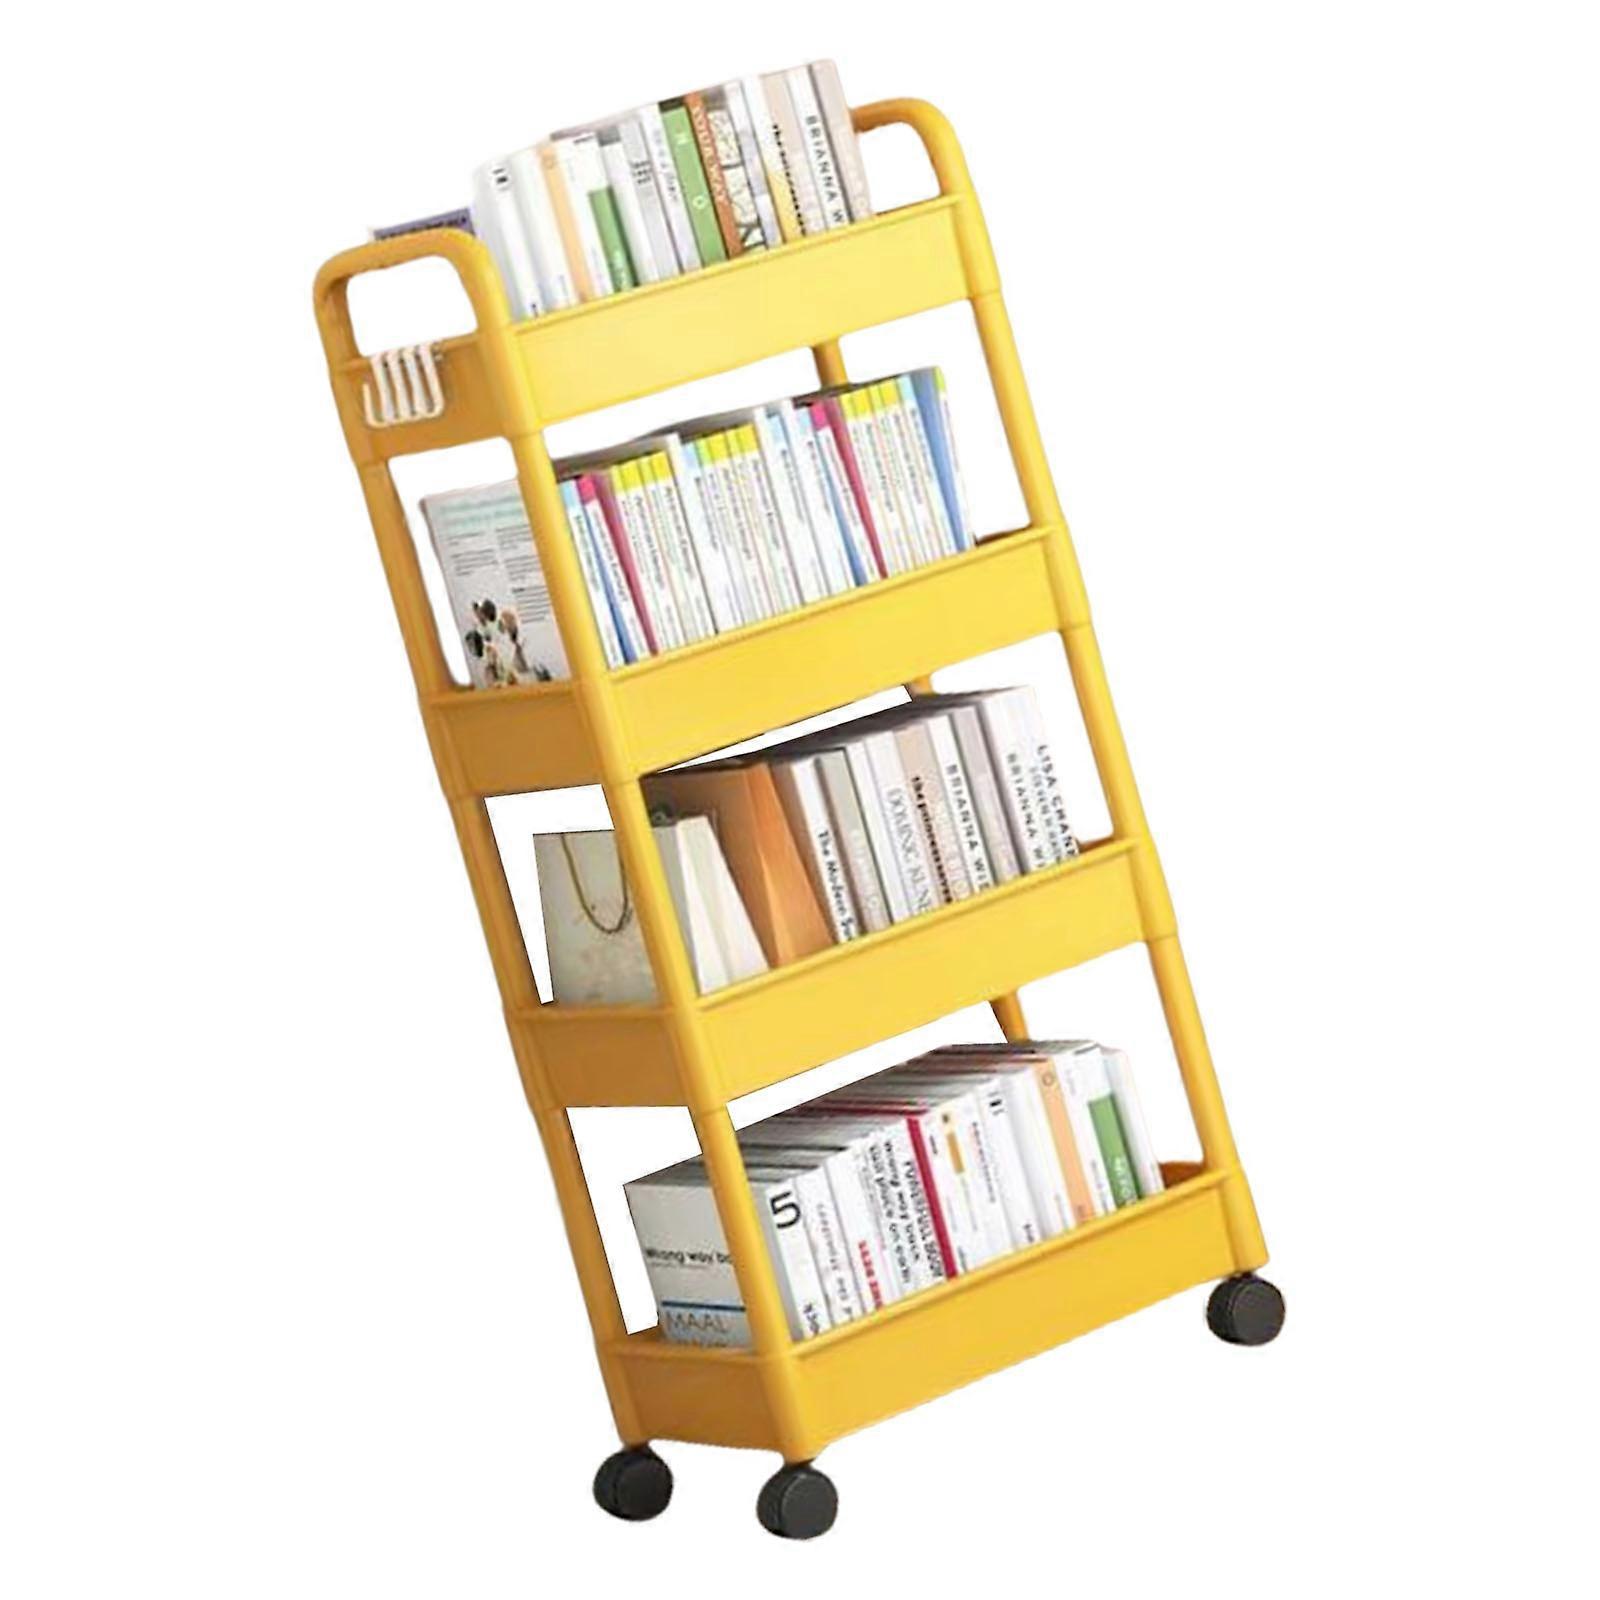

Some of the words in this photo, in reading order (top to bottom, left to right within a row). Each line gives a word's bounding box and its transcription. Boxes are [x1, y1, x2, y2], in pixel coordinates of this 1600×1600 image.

[805, 115, 838, 202] BRIANNA
[1007, 753, 1038, 839] BRIANNA
[1037, 744, 1057, 789] LISA
[817, 829, 831, 857] The
[887, 788, 920, 863] DOMINIC
[946, 763, 979, 851] BRIANNA
[769, 1191, 802, 1229] 5
[883, 1140, 901, 1188] Wrong
[897, 1191, 909, 1220] way
[905, 1223, 920, 1261] back
[643, 1247, 685, 1264] Wrong
[686, 1251, 714, 1265] way
